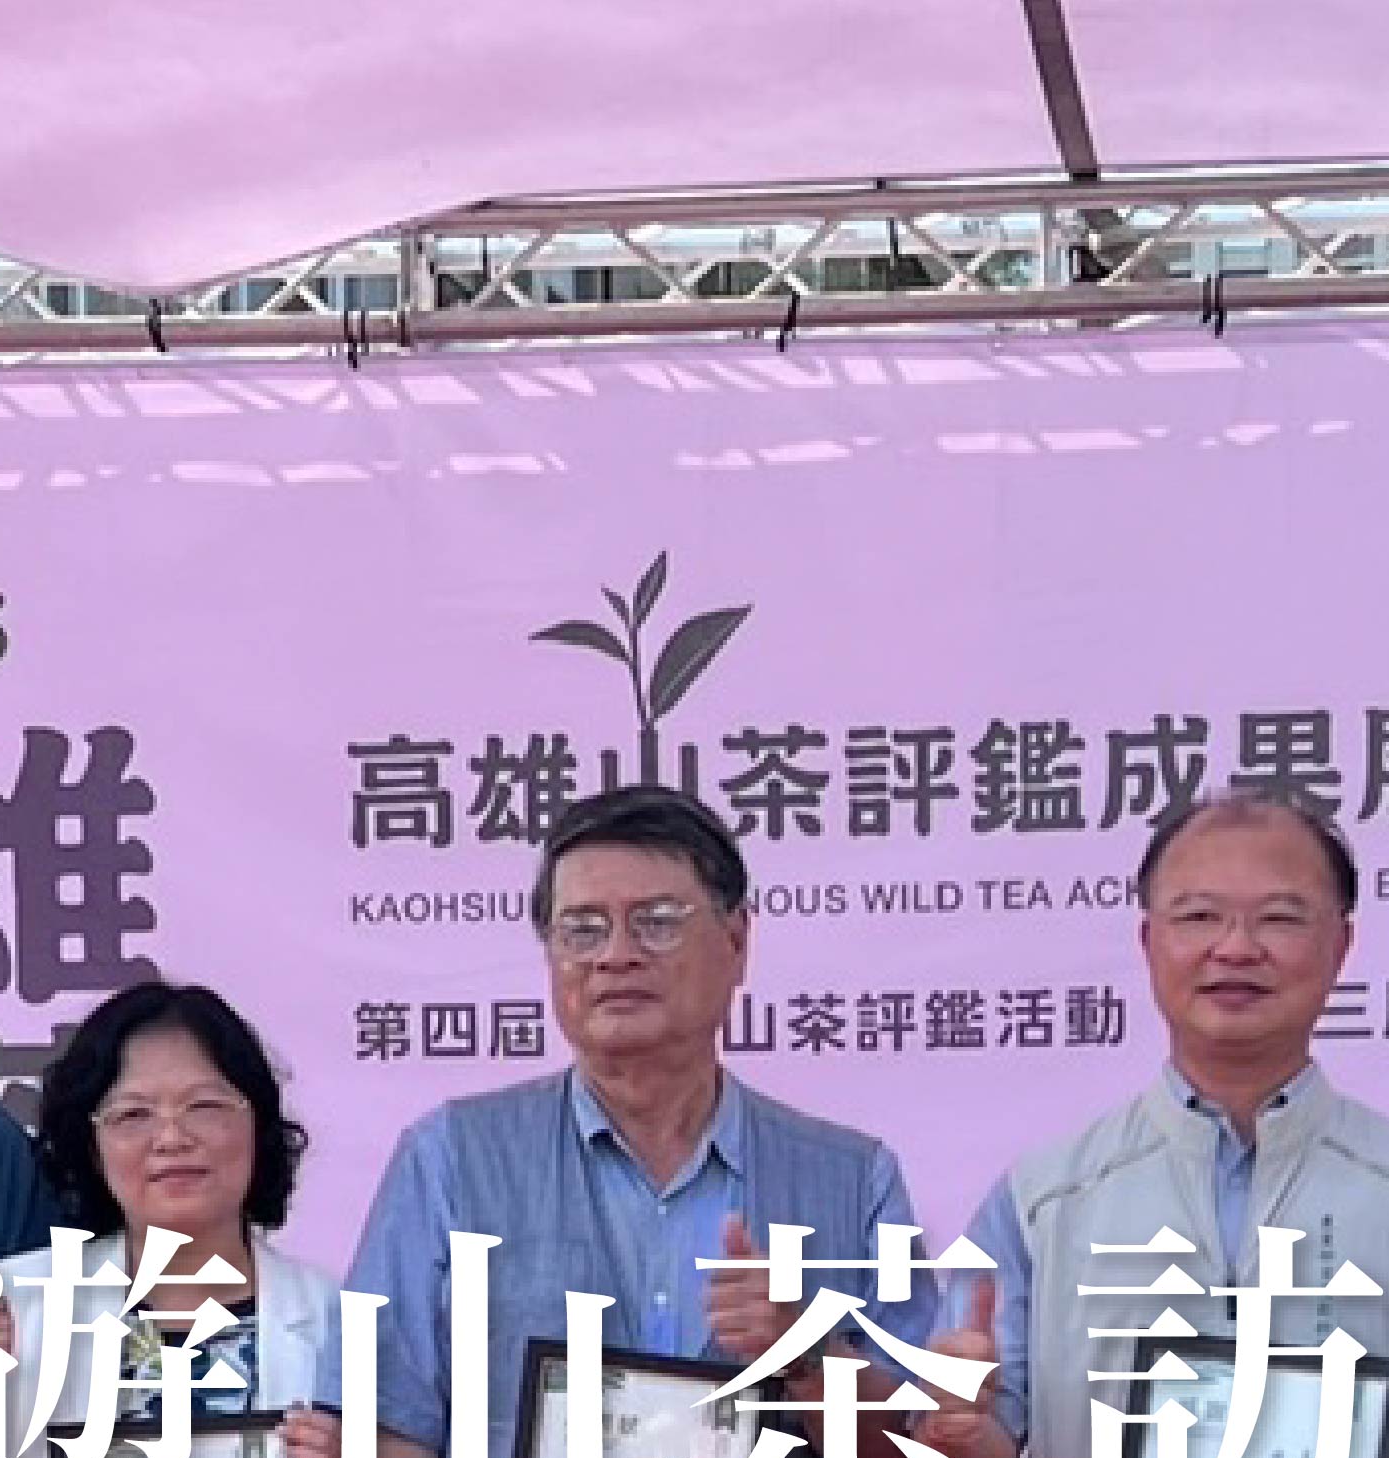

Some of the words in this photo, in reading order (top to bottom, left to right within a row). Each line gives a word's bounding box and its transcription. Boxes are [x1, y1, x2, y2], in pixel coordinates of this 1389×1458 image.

[352, 892, 525, 922] KAOHSIU
[860, 880, 964, 914] WILD
[977, 880, 1053, 910] TEA
[353, 1000, 545, 1061] 第四屆
